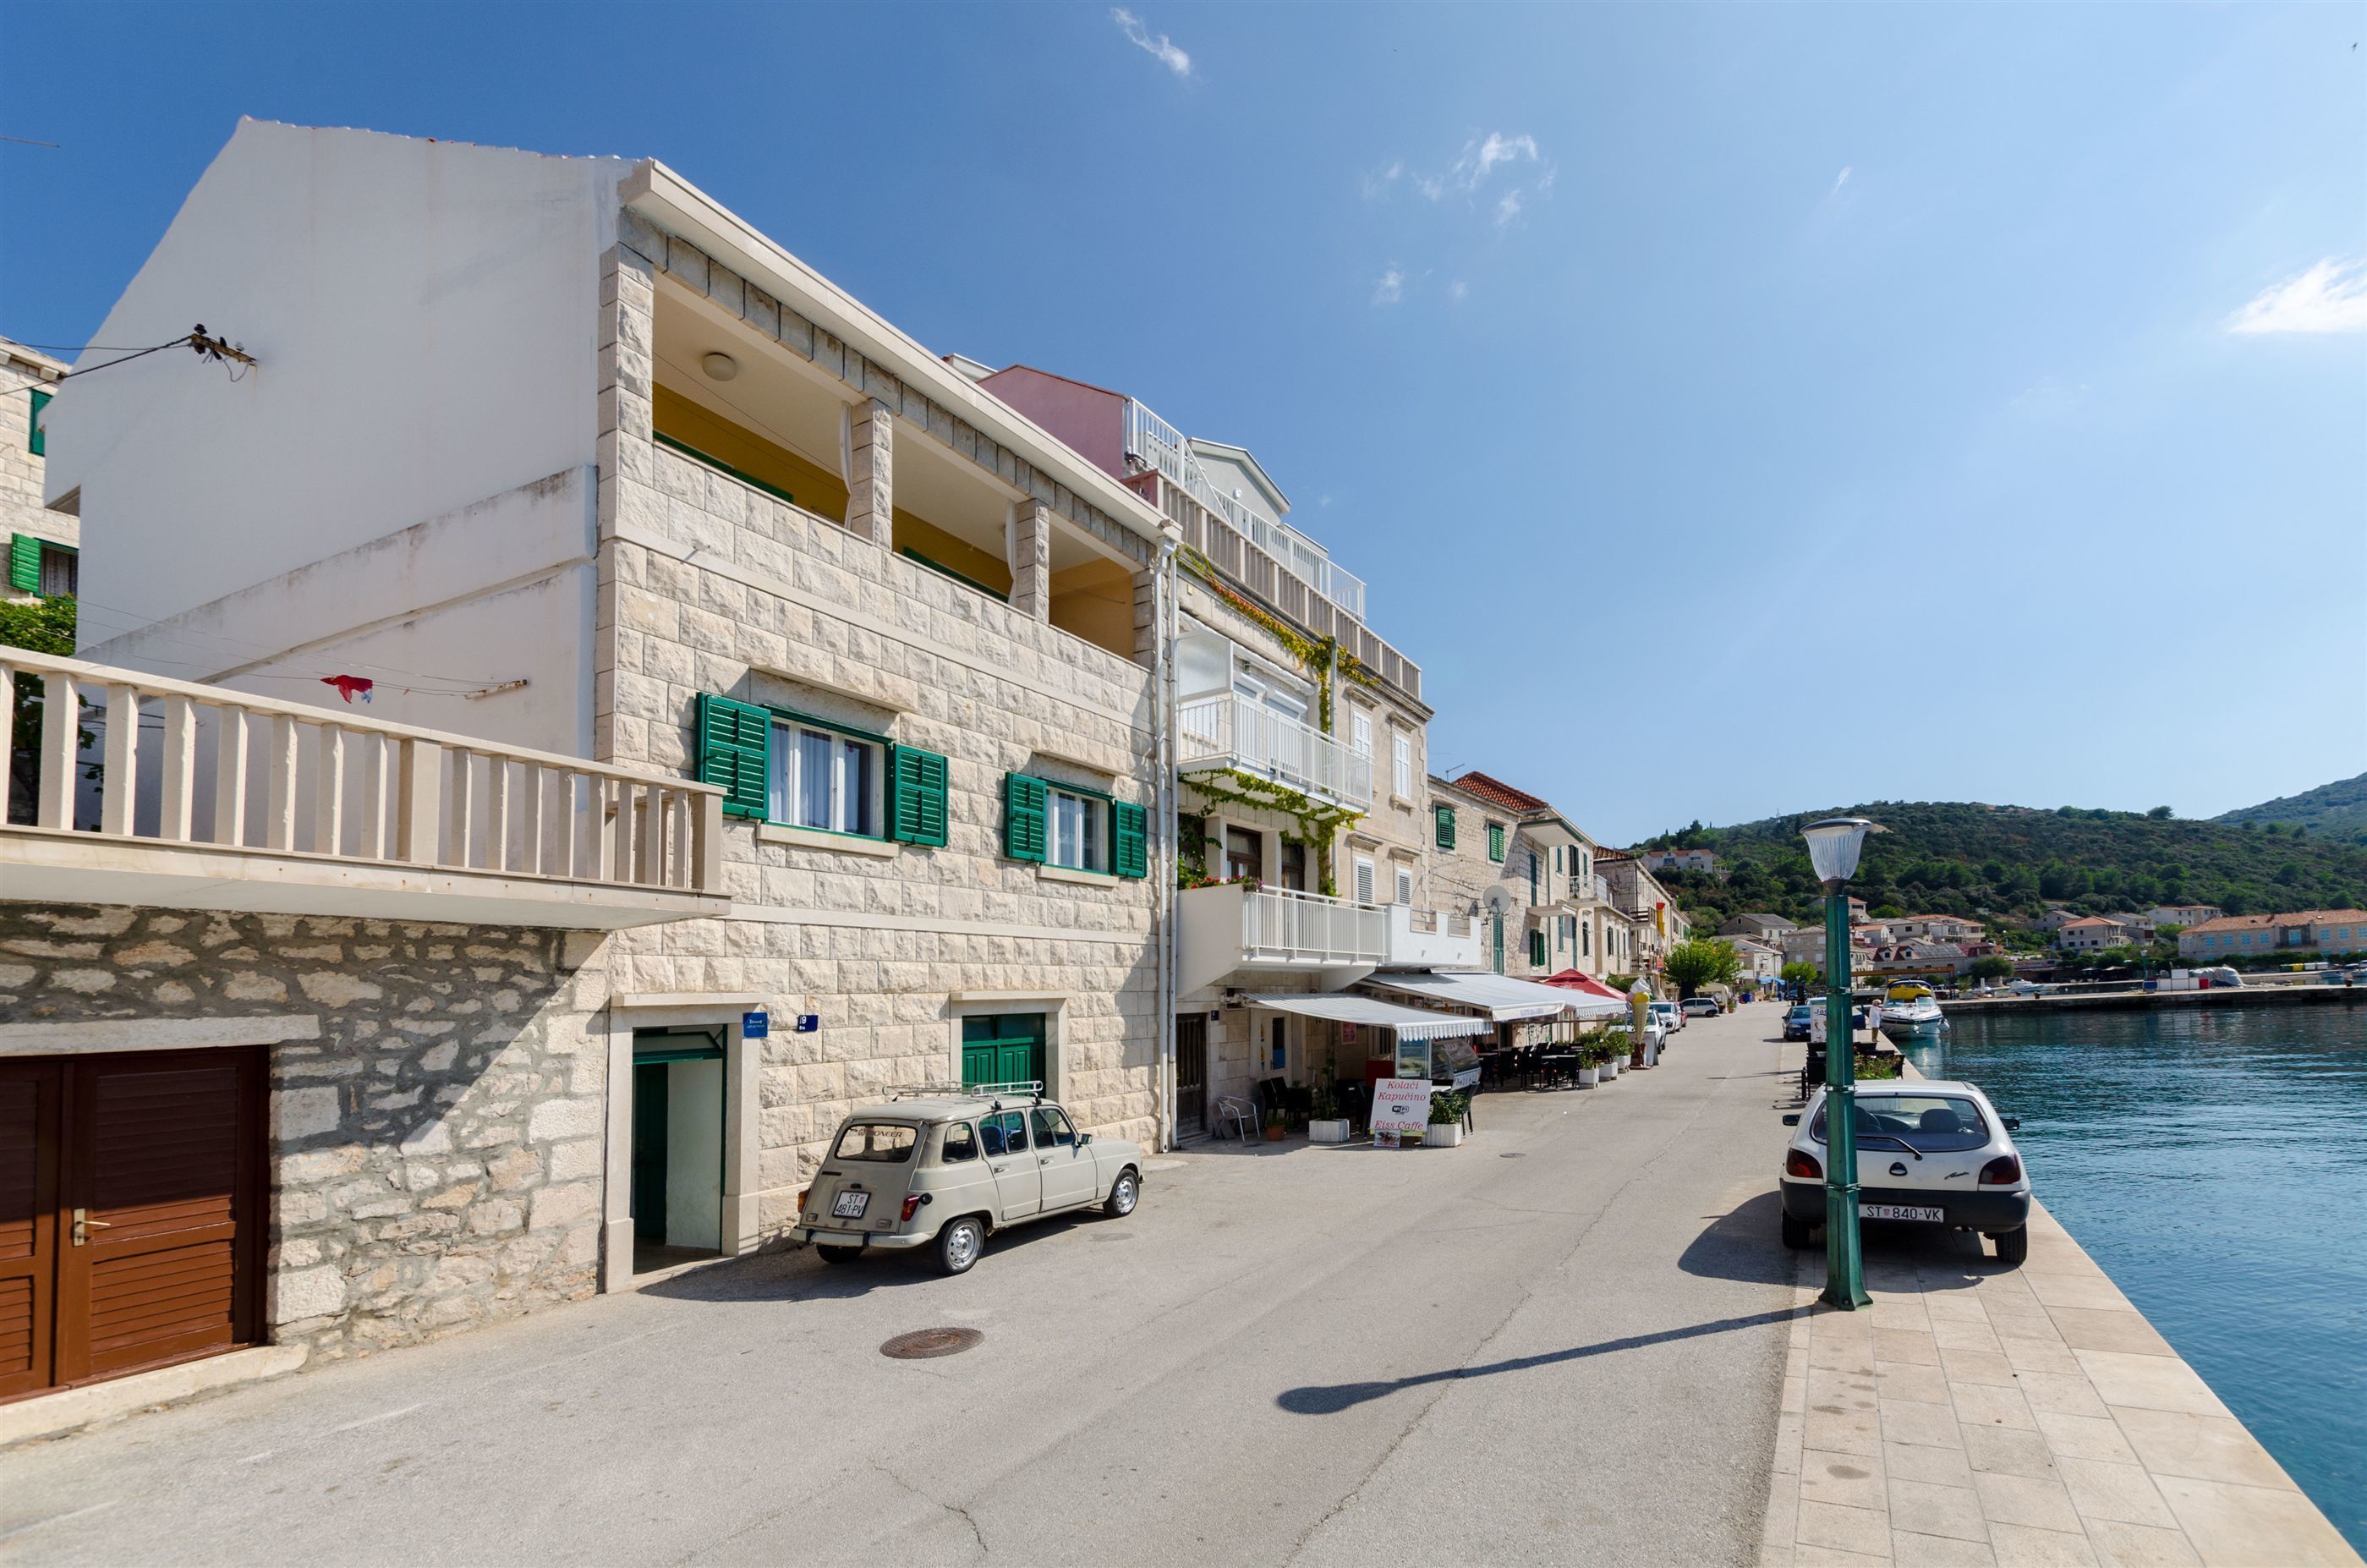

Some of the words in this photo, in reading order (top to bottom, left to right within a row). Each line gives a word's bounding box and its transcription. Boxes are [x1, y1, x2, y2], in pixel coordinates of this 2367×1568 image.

[1374, 1120, 1394, 1129] Eiss
[847, 1194, 859, 1204] ST
[1867, 1206, 1882, 1217] ST
[1893, 1207, 1941, 1220] 840-VK
